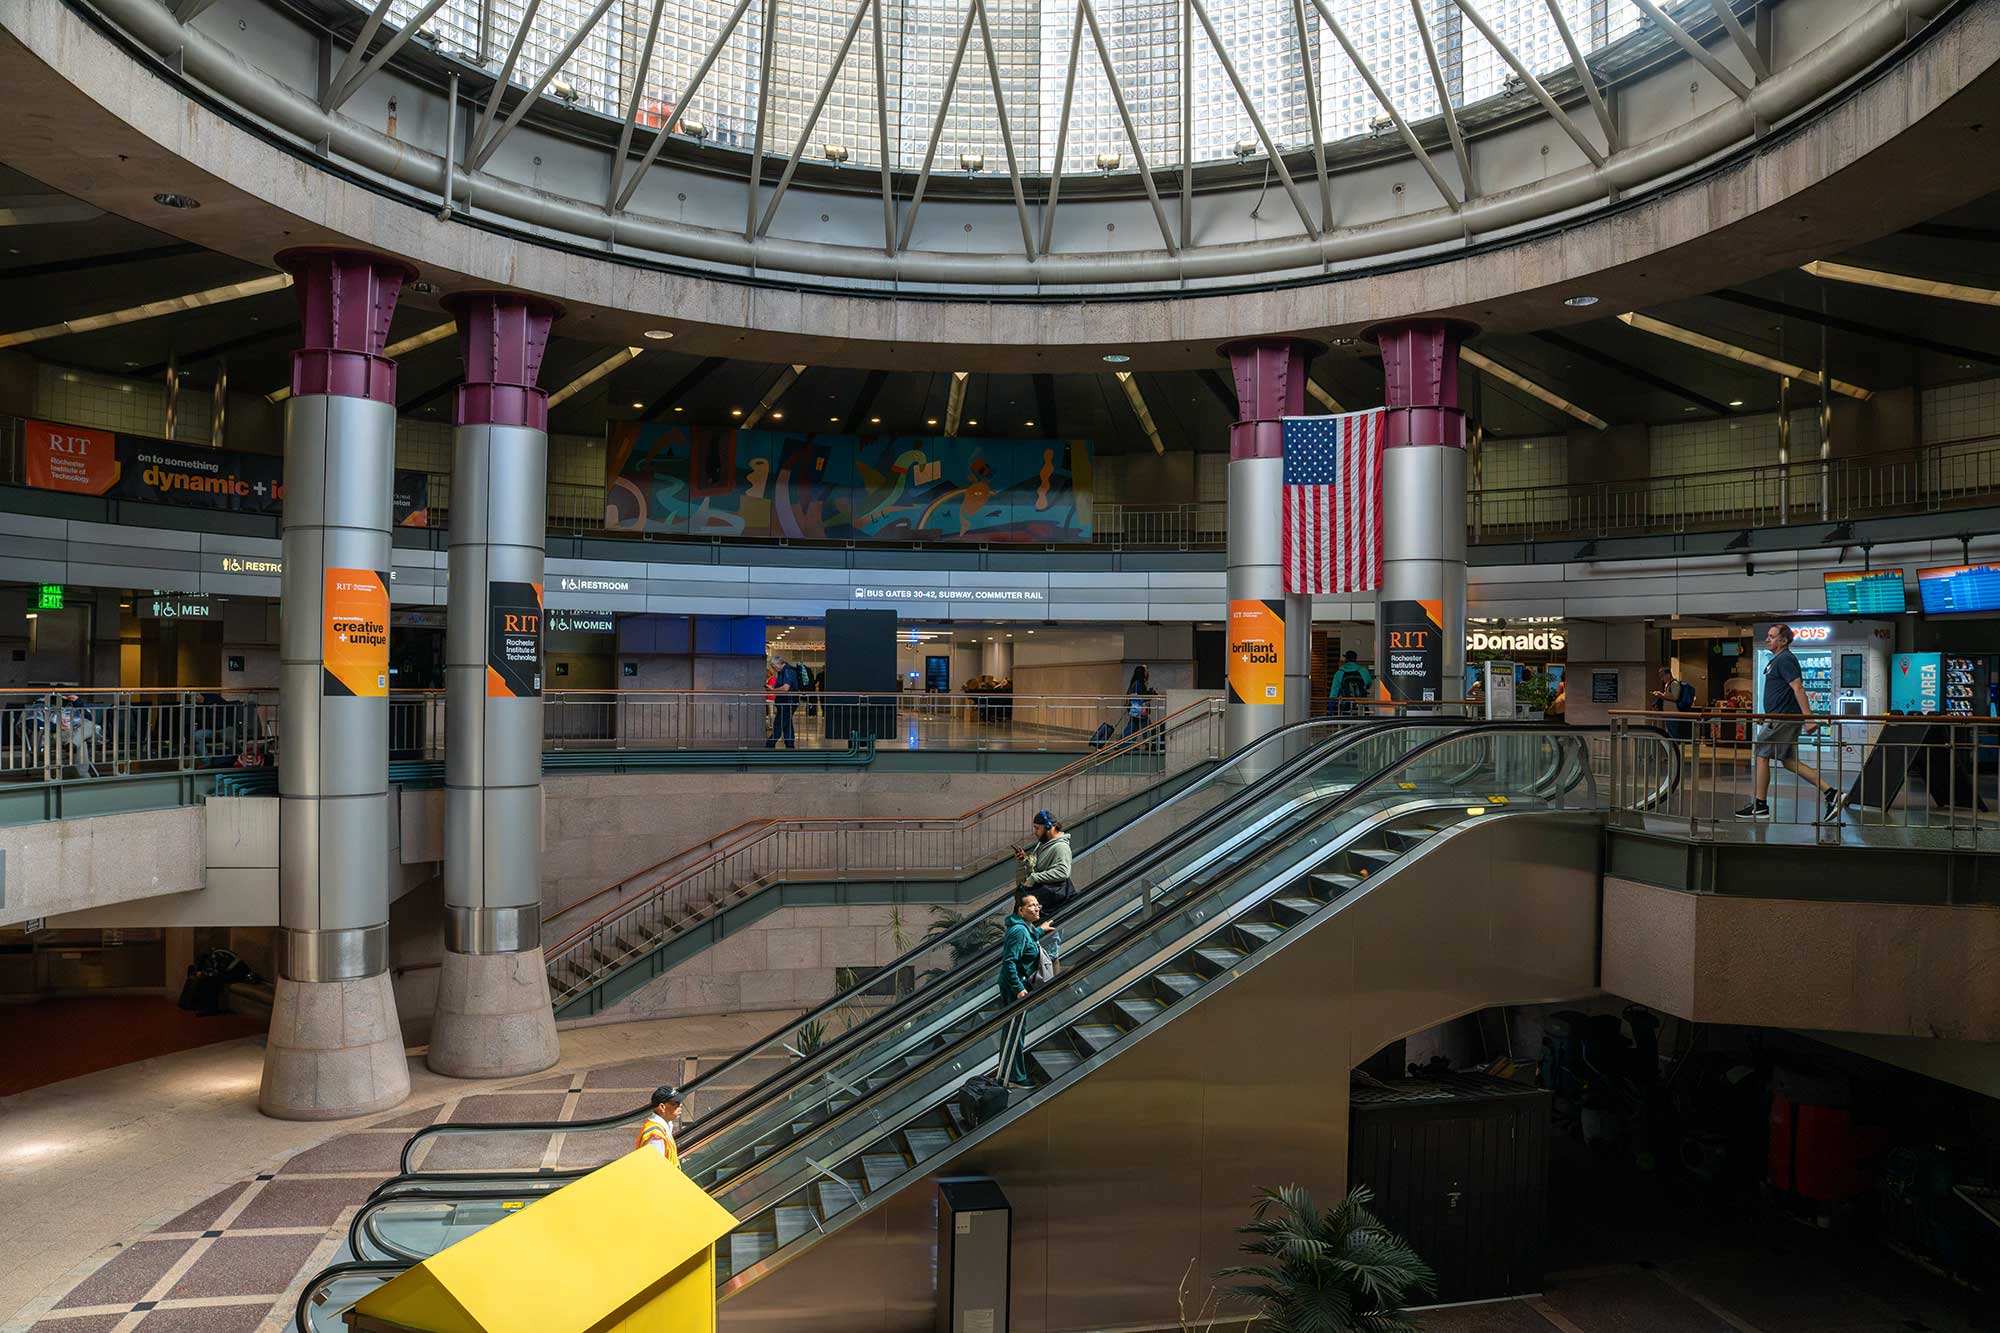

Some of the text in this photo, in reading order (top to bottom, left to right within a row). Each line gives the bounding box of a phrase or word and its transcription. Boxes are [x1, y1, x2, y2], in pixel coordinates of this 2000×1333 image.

[49, 433, 91, 456] RIT
[138, 453, 219, 473] on to something
[143, 465, 249, 496] dynamic
[245, 561, 282, 573] RESTRO
[581, 581, 629, 591] RESTROOM
[866, 589, 1043, 600] BUS GATES 30-42, SUBWAY, COMMUTER RAIL
[42, 594, 62, 608] EXIT
[181, 605, 209, 616] MEN
[333, 621, 384, 633] creative
[504, 614, 539, 633] RIT
[573, 620, 613, 630] WOMEN
[1800, 628, 1826, 639] CVS
[349, 633, 387, 647] unique
[505, 638, 535, 647] Rochester
[1389, 631, 1428, 649] RIT
[1465, 632, 1565, 651] cDonald's
[505, 646, 530, 654] Institute
[1232, 643, 1274, 653] brilliant
[1250, 652, 1278, 664] bold
[1390, 654, 1422, 662] Rochester
[1390, 661, 1423, 669] Institute of
[1391, 668, 1427, 677] Technology
[1921, 663, 1937, 697] AREA
